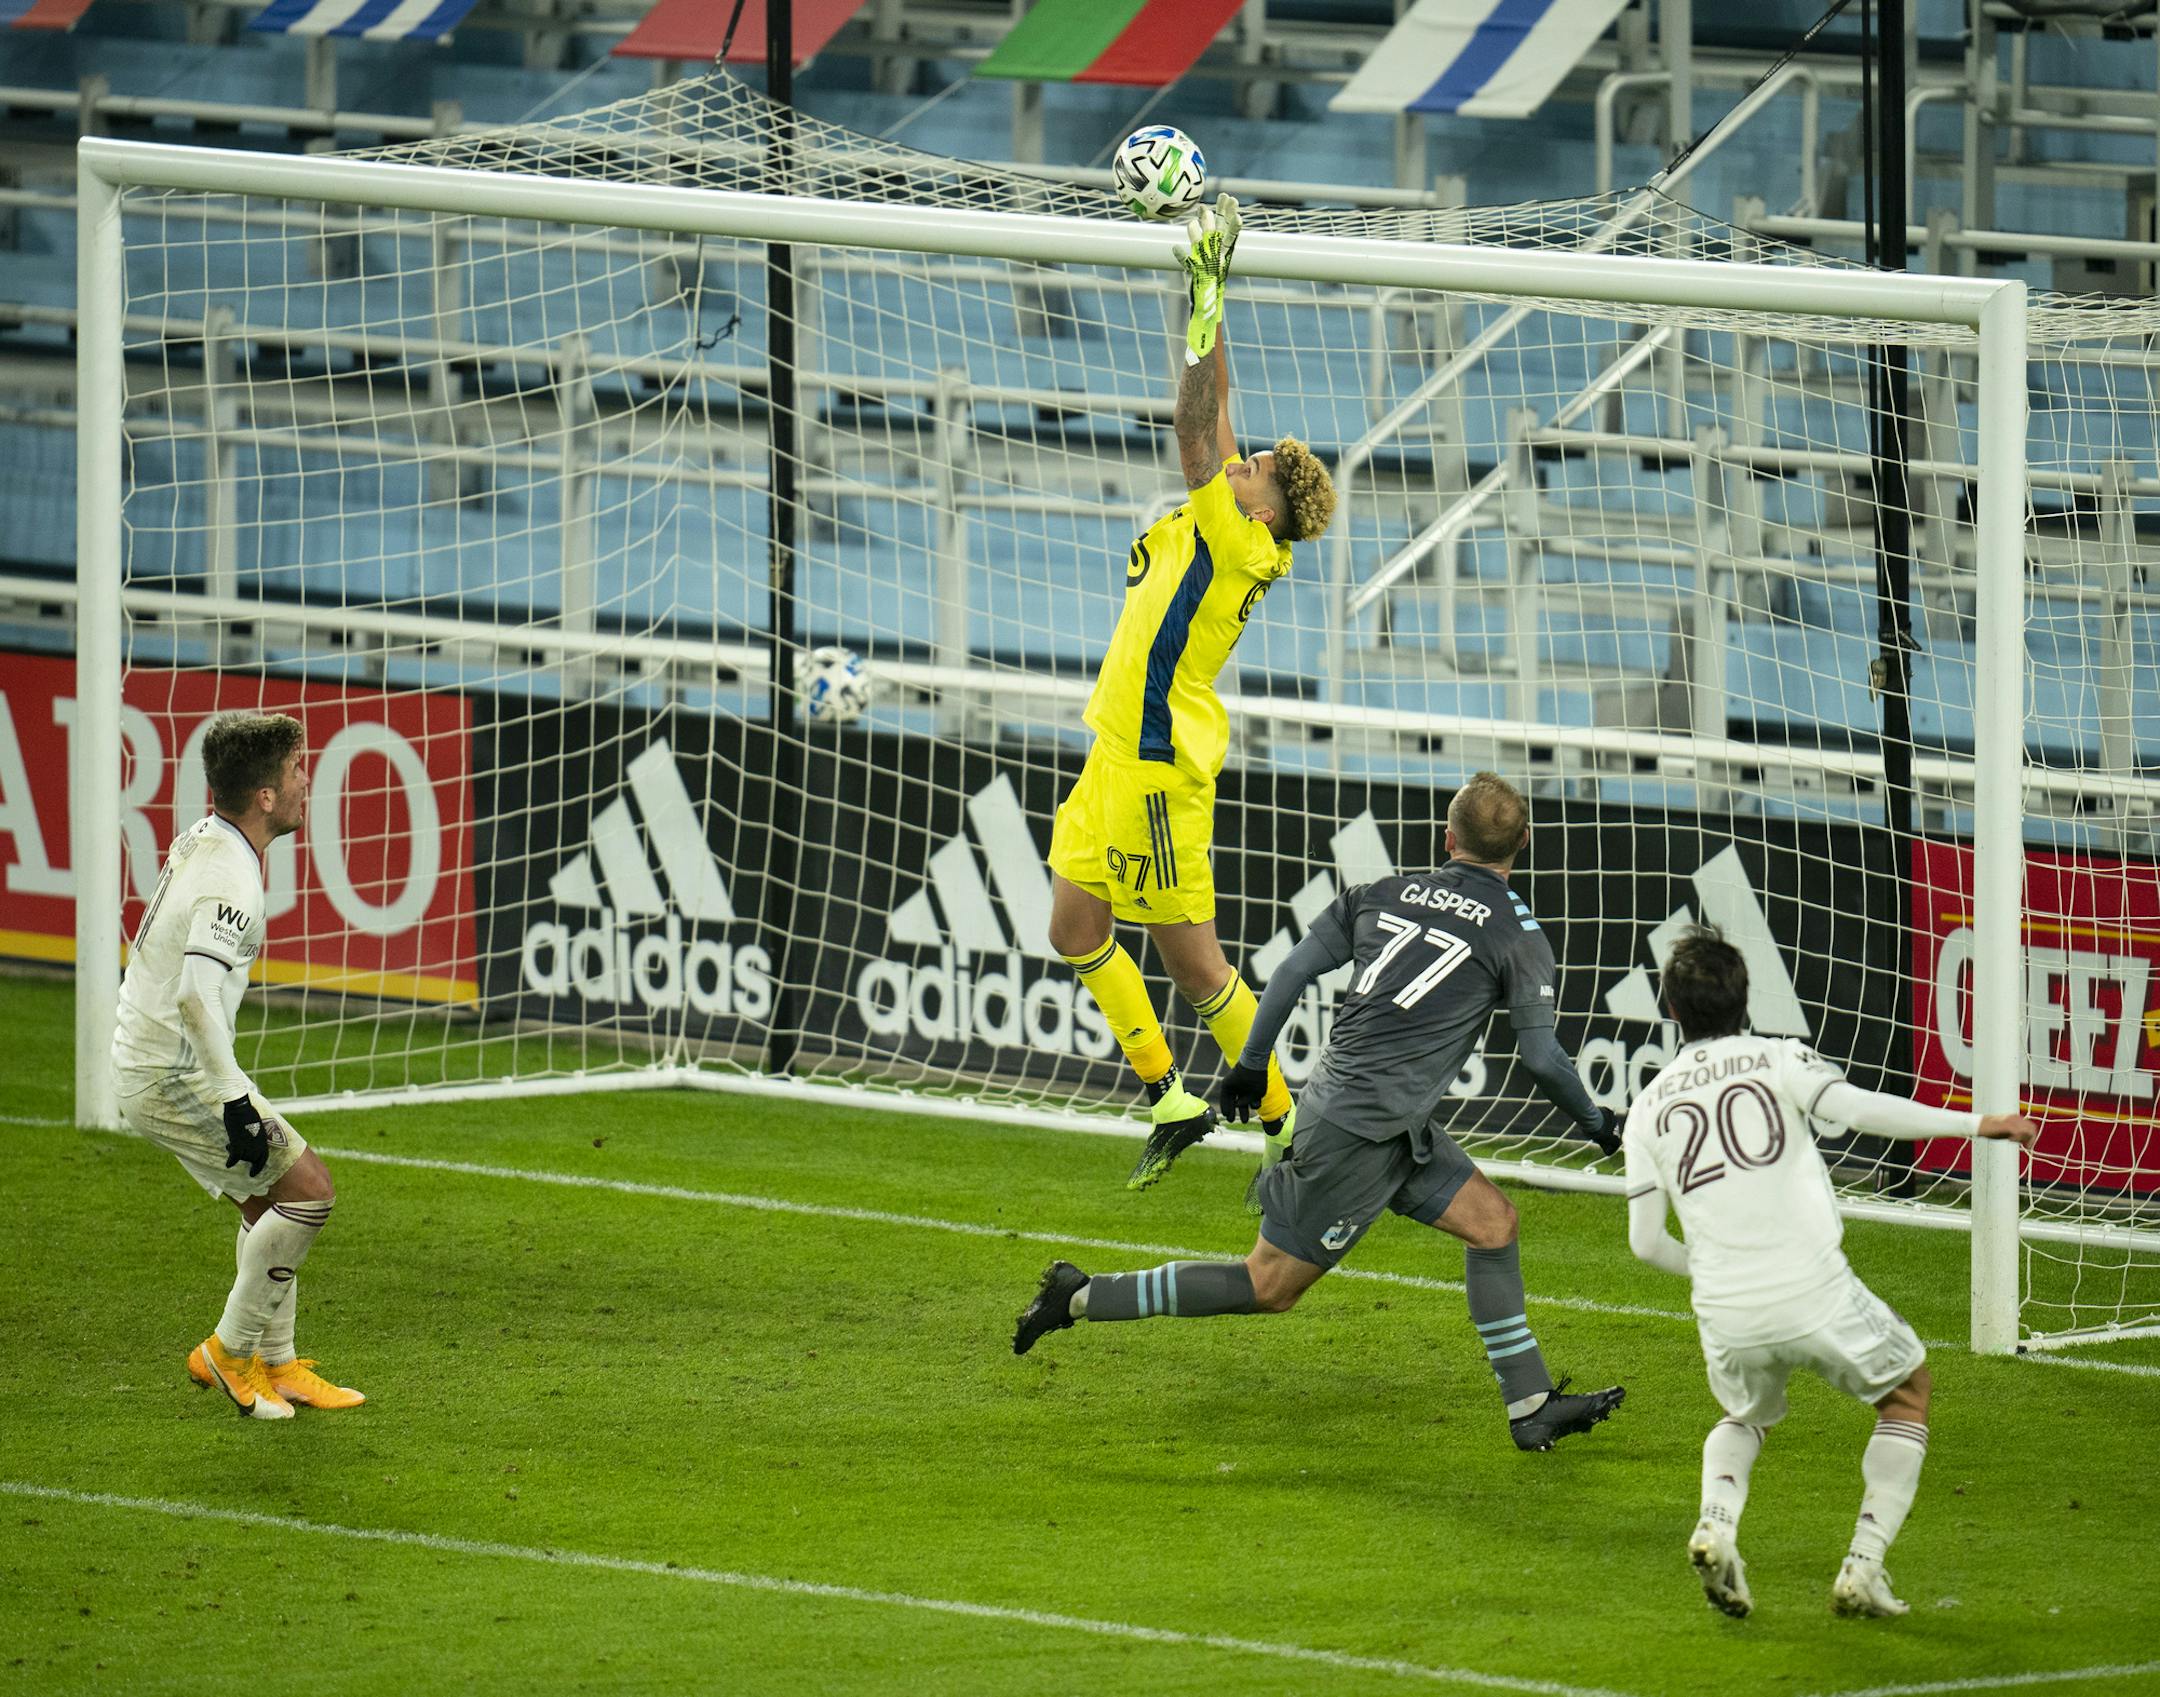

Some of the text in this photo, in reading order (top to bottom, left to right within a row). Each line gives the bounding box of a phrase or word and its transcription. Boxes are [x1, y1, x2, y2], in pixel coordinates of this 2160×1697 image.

[217, 903, 250, 932] WU
[1107, 845, 1152, 892] 97
[1400, 883, 1492, 927] GASPER
[523, 906, 773, 1020] adidas
[856, 942, 1116, 1059] adidas
[1355, 912, 1472, 1010] 77
[1656, 1078, 1785, 1195] 20
